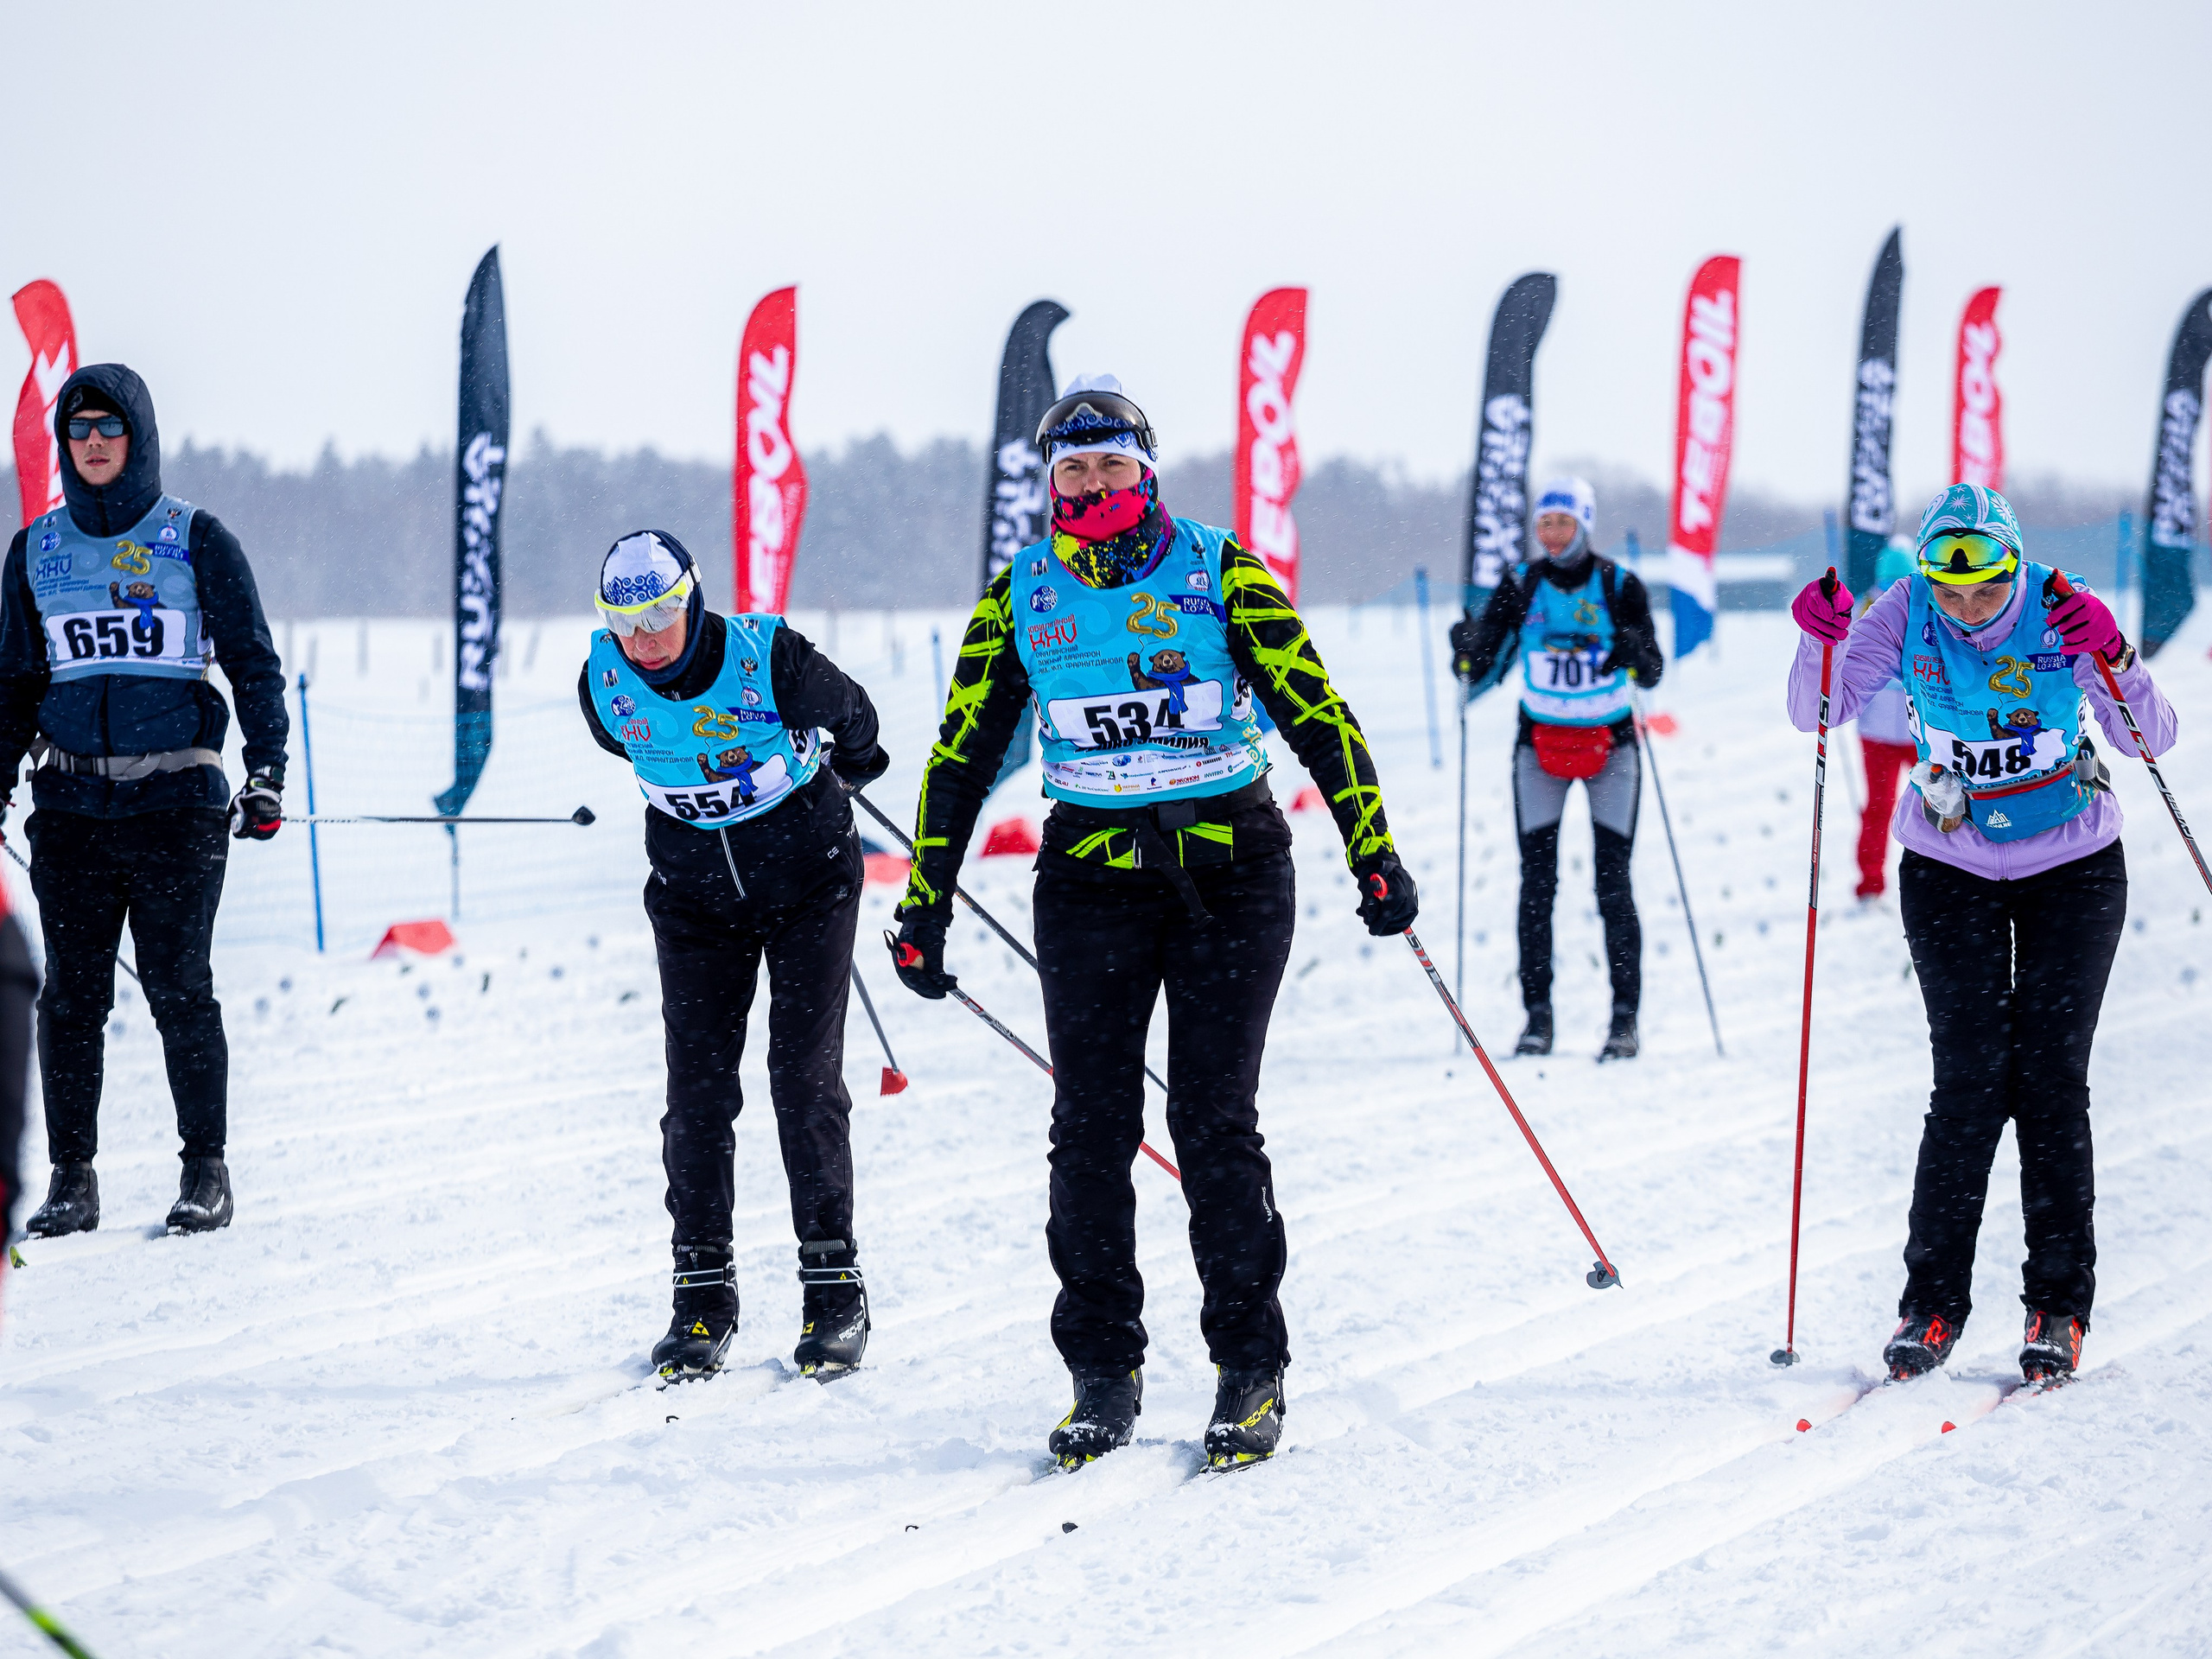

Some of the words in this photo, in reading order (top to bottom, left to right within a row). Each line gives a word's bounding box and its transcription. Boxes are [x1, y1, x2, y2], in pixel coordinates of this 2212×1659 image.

[1679, 288, 1735, 534] TEBOIL
[747, 344, 792, 613] EBOIL
[111, 539, 153, 575] 25
[1127, 592, 1181, 639] 25
[63, 614, 164, 658] 659
[1029, 622, 1077, 652] XXV
[1064, 650, 1102, 662] МАРАФОН
[1065, 657, 1124, 670] ФАРХУТДИНОВА
[1545, 654, 1597, 687] 701
[2037, 654, 2067, 664] RUSSIA
[1988, 656, 2036, 698] 25
[692, 705, 739, 741] 25
[1084, 701, 1185, 745] 534
[1204, 770, 1224, 779] INVITRO
[1951, 740, 2031, 779] 548
[664, 785, 756, 821] 554
[1239, 1397, 1274, 1428] FISCHER
